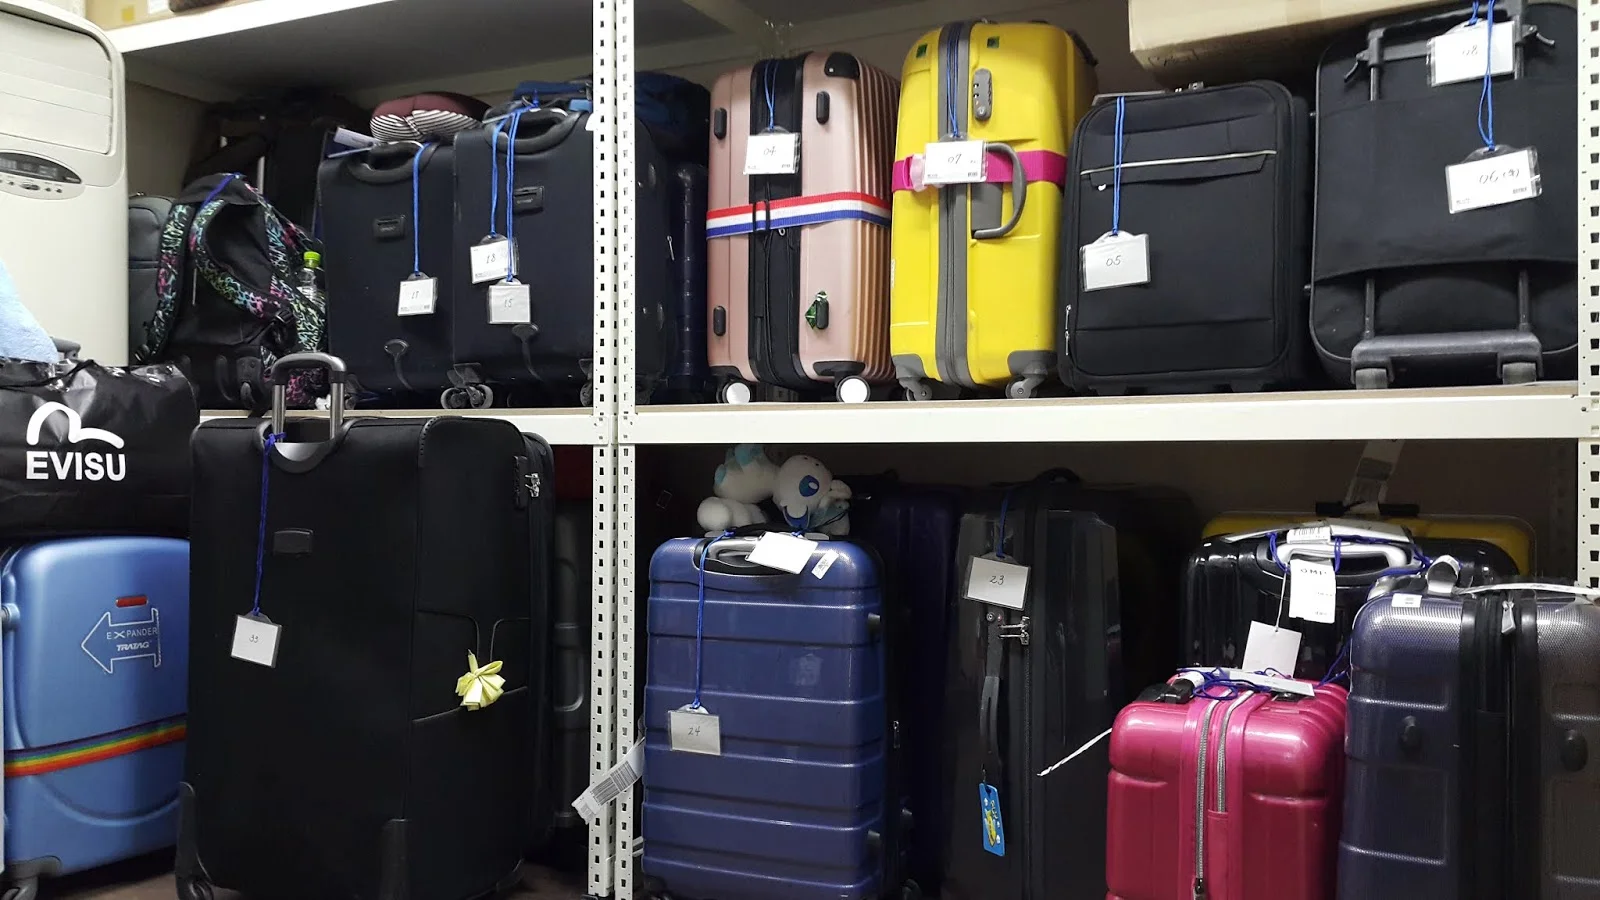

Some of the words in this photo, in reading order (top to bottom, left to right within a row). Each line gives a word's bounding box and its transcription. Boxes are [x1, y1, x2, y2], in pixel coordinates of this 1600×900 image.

[947, 153, 962, 164] 07
[1479, 169, 1499, 184] 06
[486, 252, 496, 264] 18
[1105, 254, 1121, 267] 05
[504, 298, 513, 308] 15
[26, 450, 126, 481] EVISU
[989, 574, 1005, 586] 23
[106, 626, 158, 640] EXPANDER
[687, 725, 701, 737] 24
